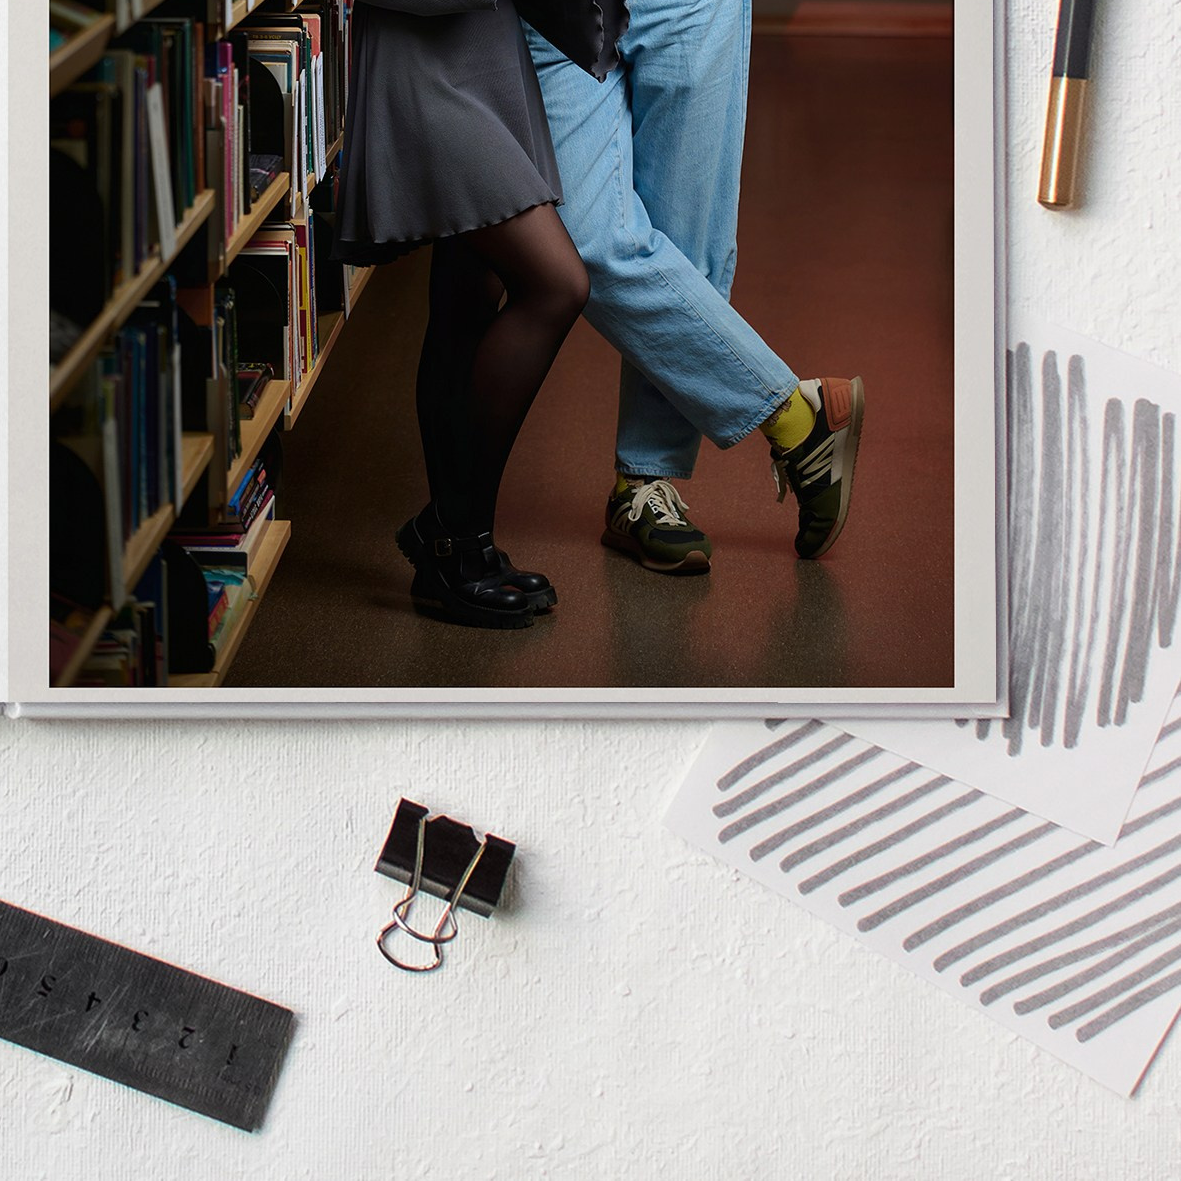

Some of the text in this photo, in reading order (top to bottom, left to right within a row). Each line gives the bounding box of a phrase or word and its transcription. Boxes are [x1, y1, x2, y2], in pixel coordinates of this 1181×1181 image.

[37, 974, 57, 998] 5
[85, 991, 102, 1013] 4
[131, 1009, 149, 1033] 3
[178, 1026, 196, 1050] 2
[227, 1044, 239, 1066] 1
